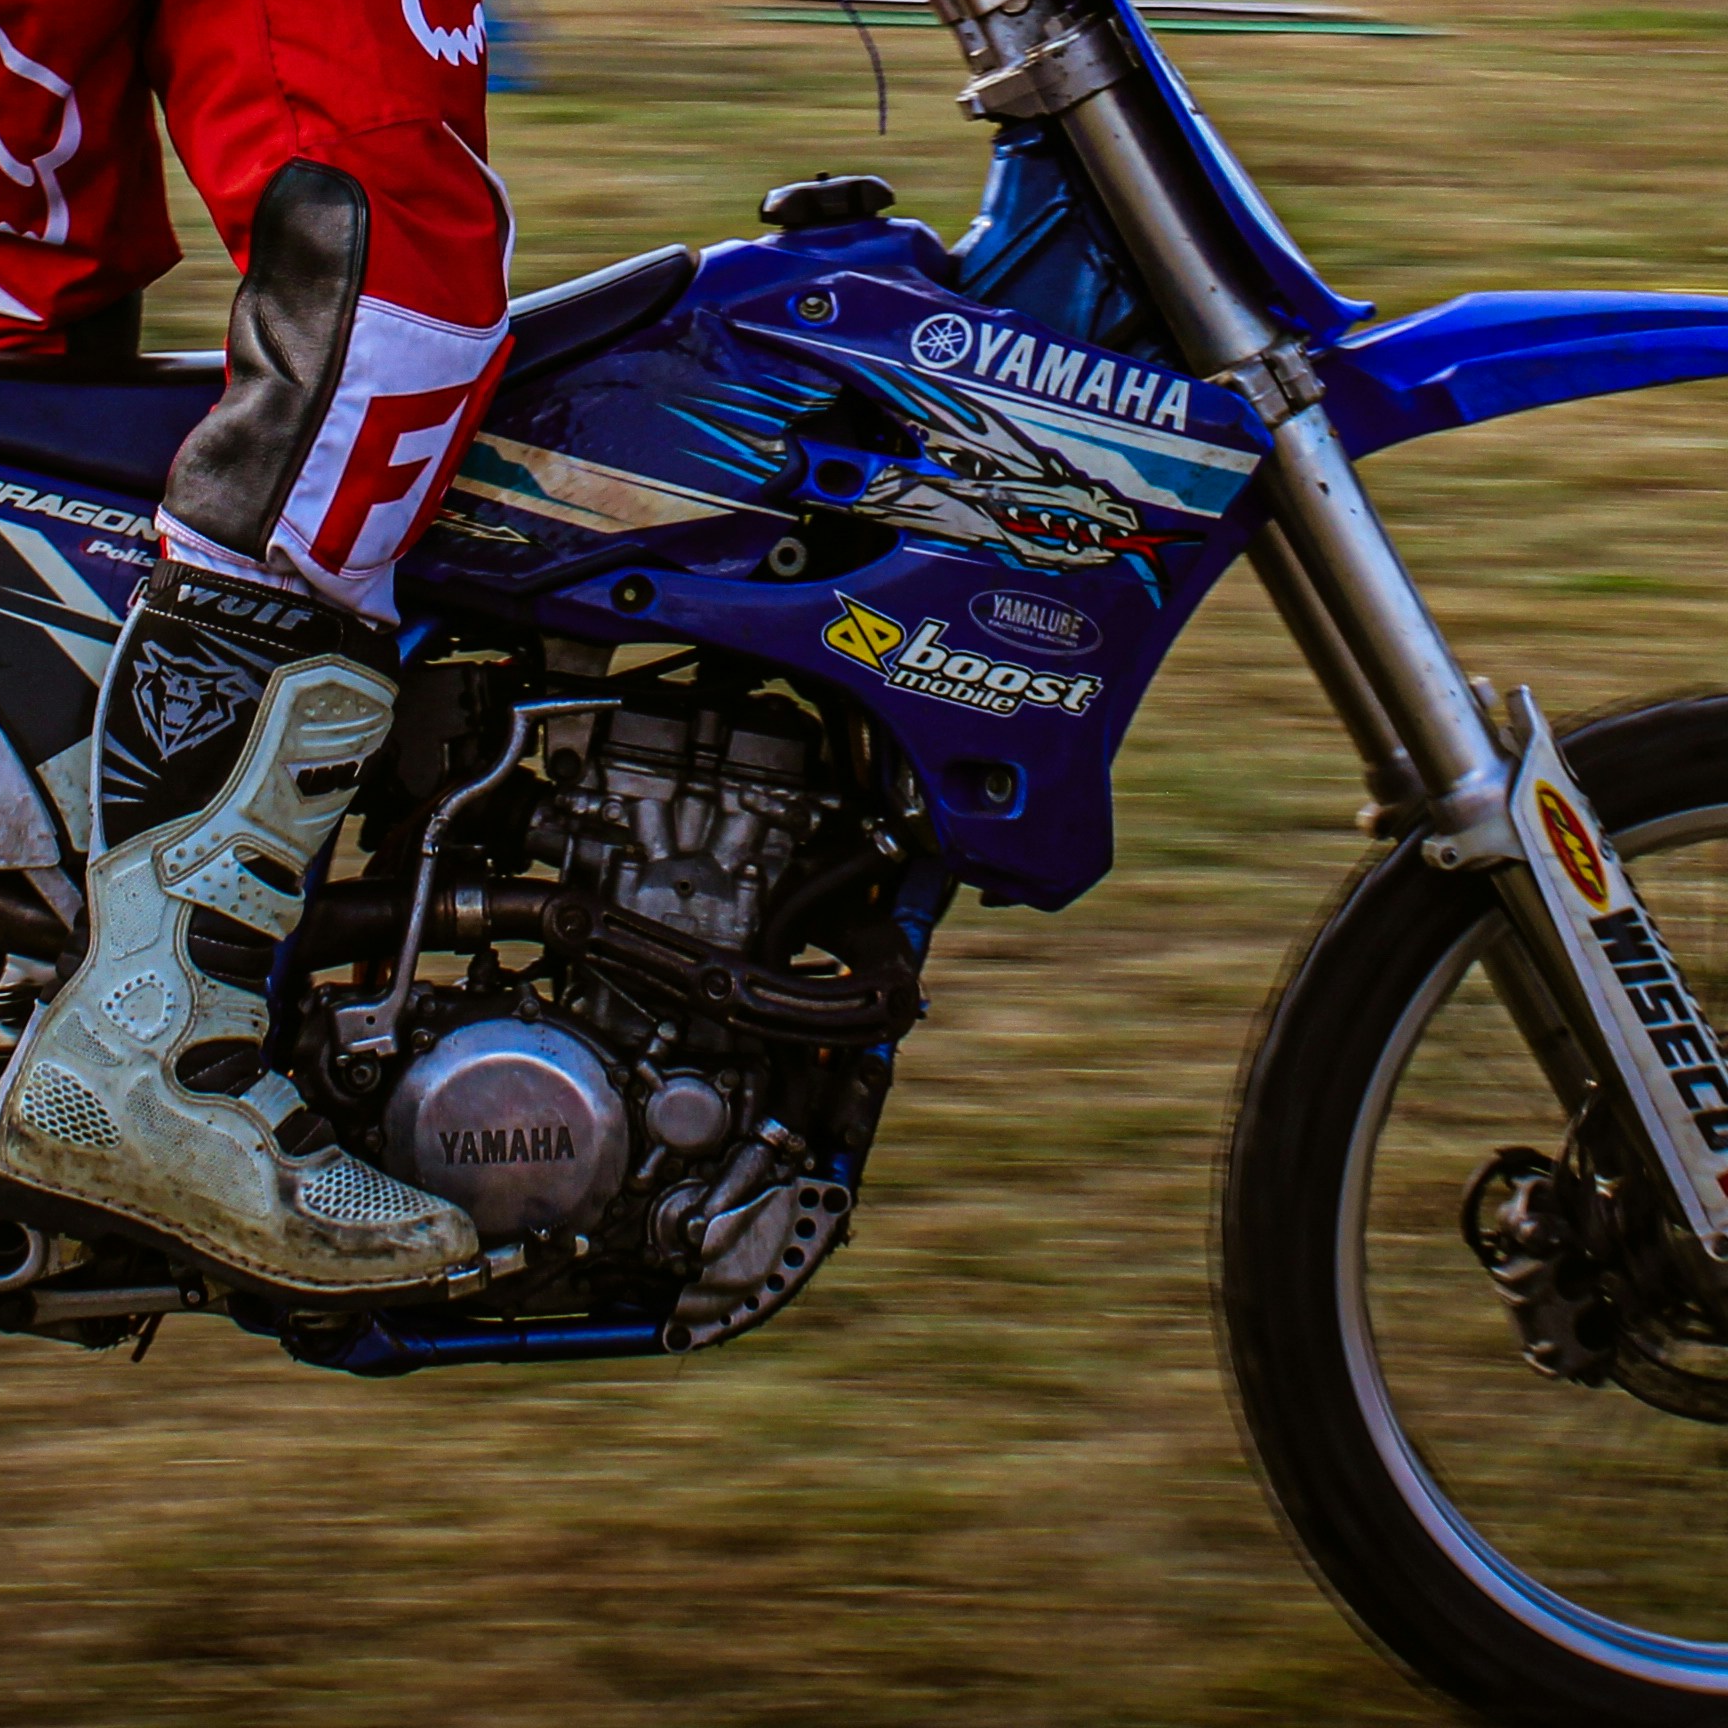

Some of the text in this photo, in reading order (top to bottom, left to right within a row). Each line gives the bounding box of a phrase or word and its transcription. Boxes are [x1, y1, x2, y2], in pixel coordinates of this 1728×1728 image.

[973, 322, 1191, 432] YAMAHA
[993, 594, 1084, 640] YAMALUBE
[892, 669, 1017, 713] mobile
[897, 619, 1096, 711] boost
[1537, 789, 1608, 902] FMF
[438, 1125, 576, 1165] YAMAHA
